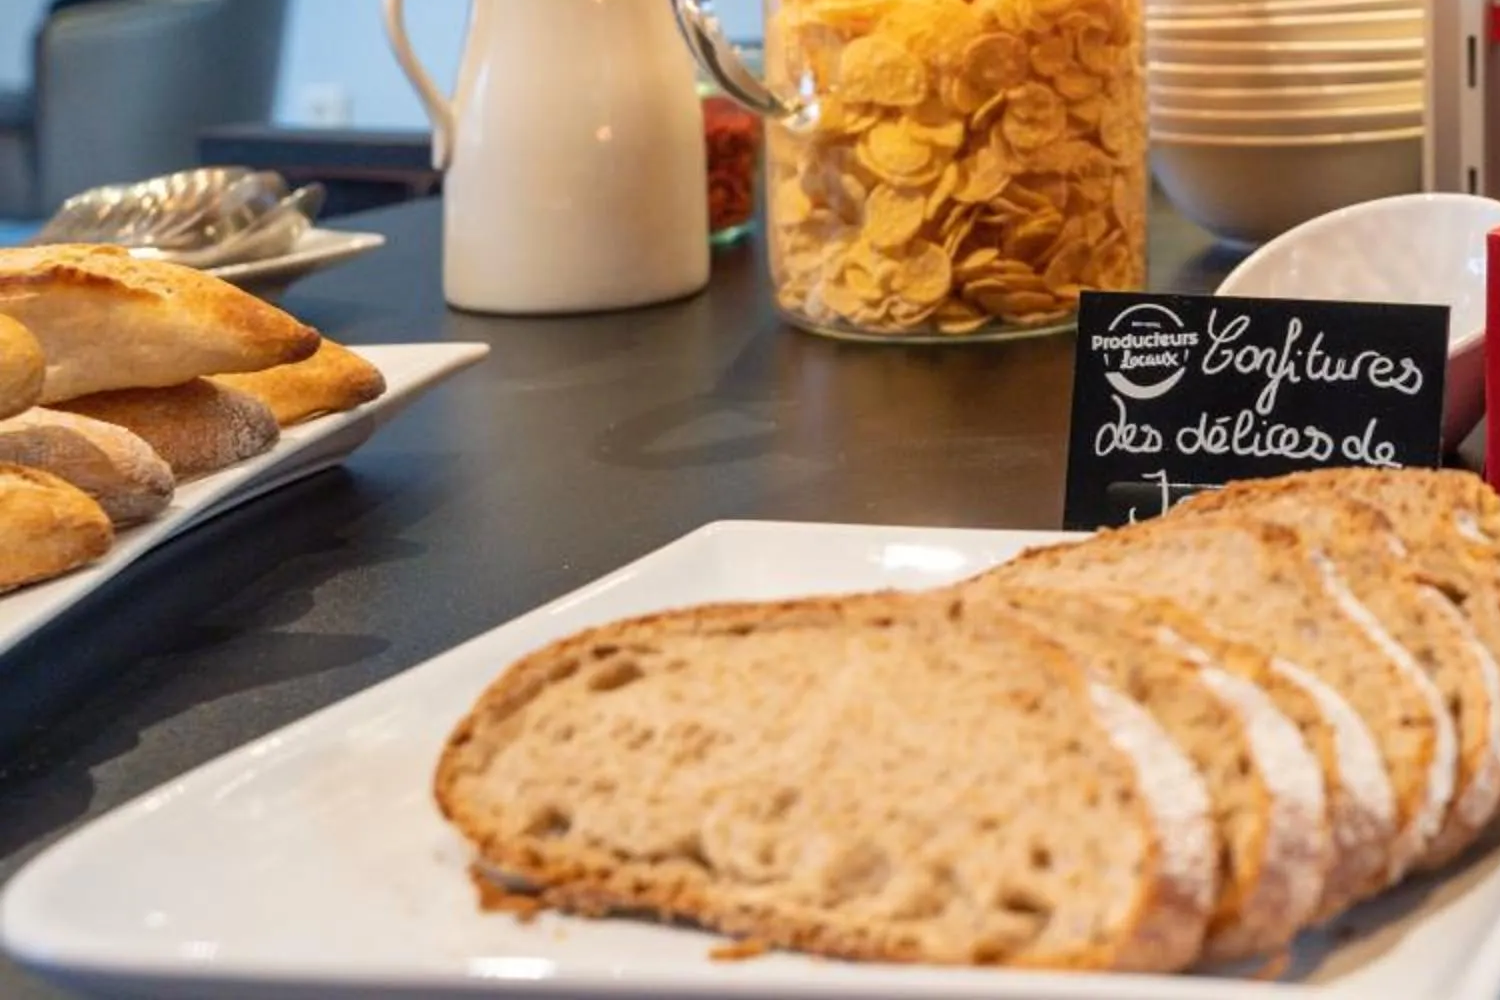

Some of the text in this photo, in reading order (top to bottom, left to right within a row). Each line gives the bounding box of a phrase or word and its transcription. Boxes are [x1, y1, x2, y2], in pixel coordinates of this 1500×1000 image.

[1091, 331, 1200, 351] Producteurs
[1119, 349, 1179, 370] Locaux
[1202, 307, 1424, 415] Confitures
[1175, 409, 1335, 462] délices
[1341, 417, 1403, 469] de
